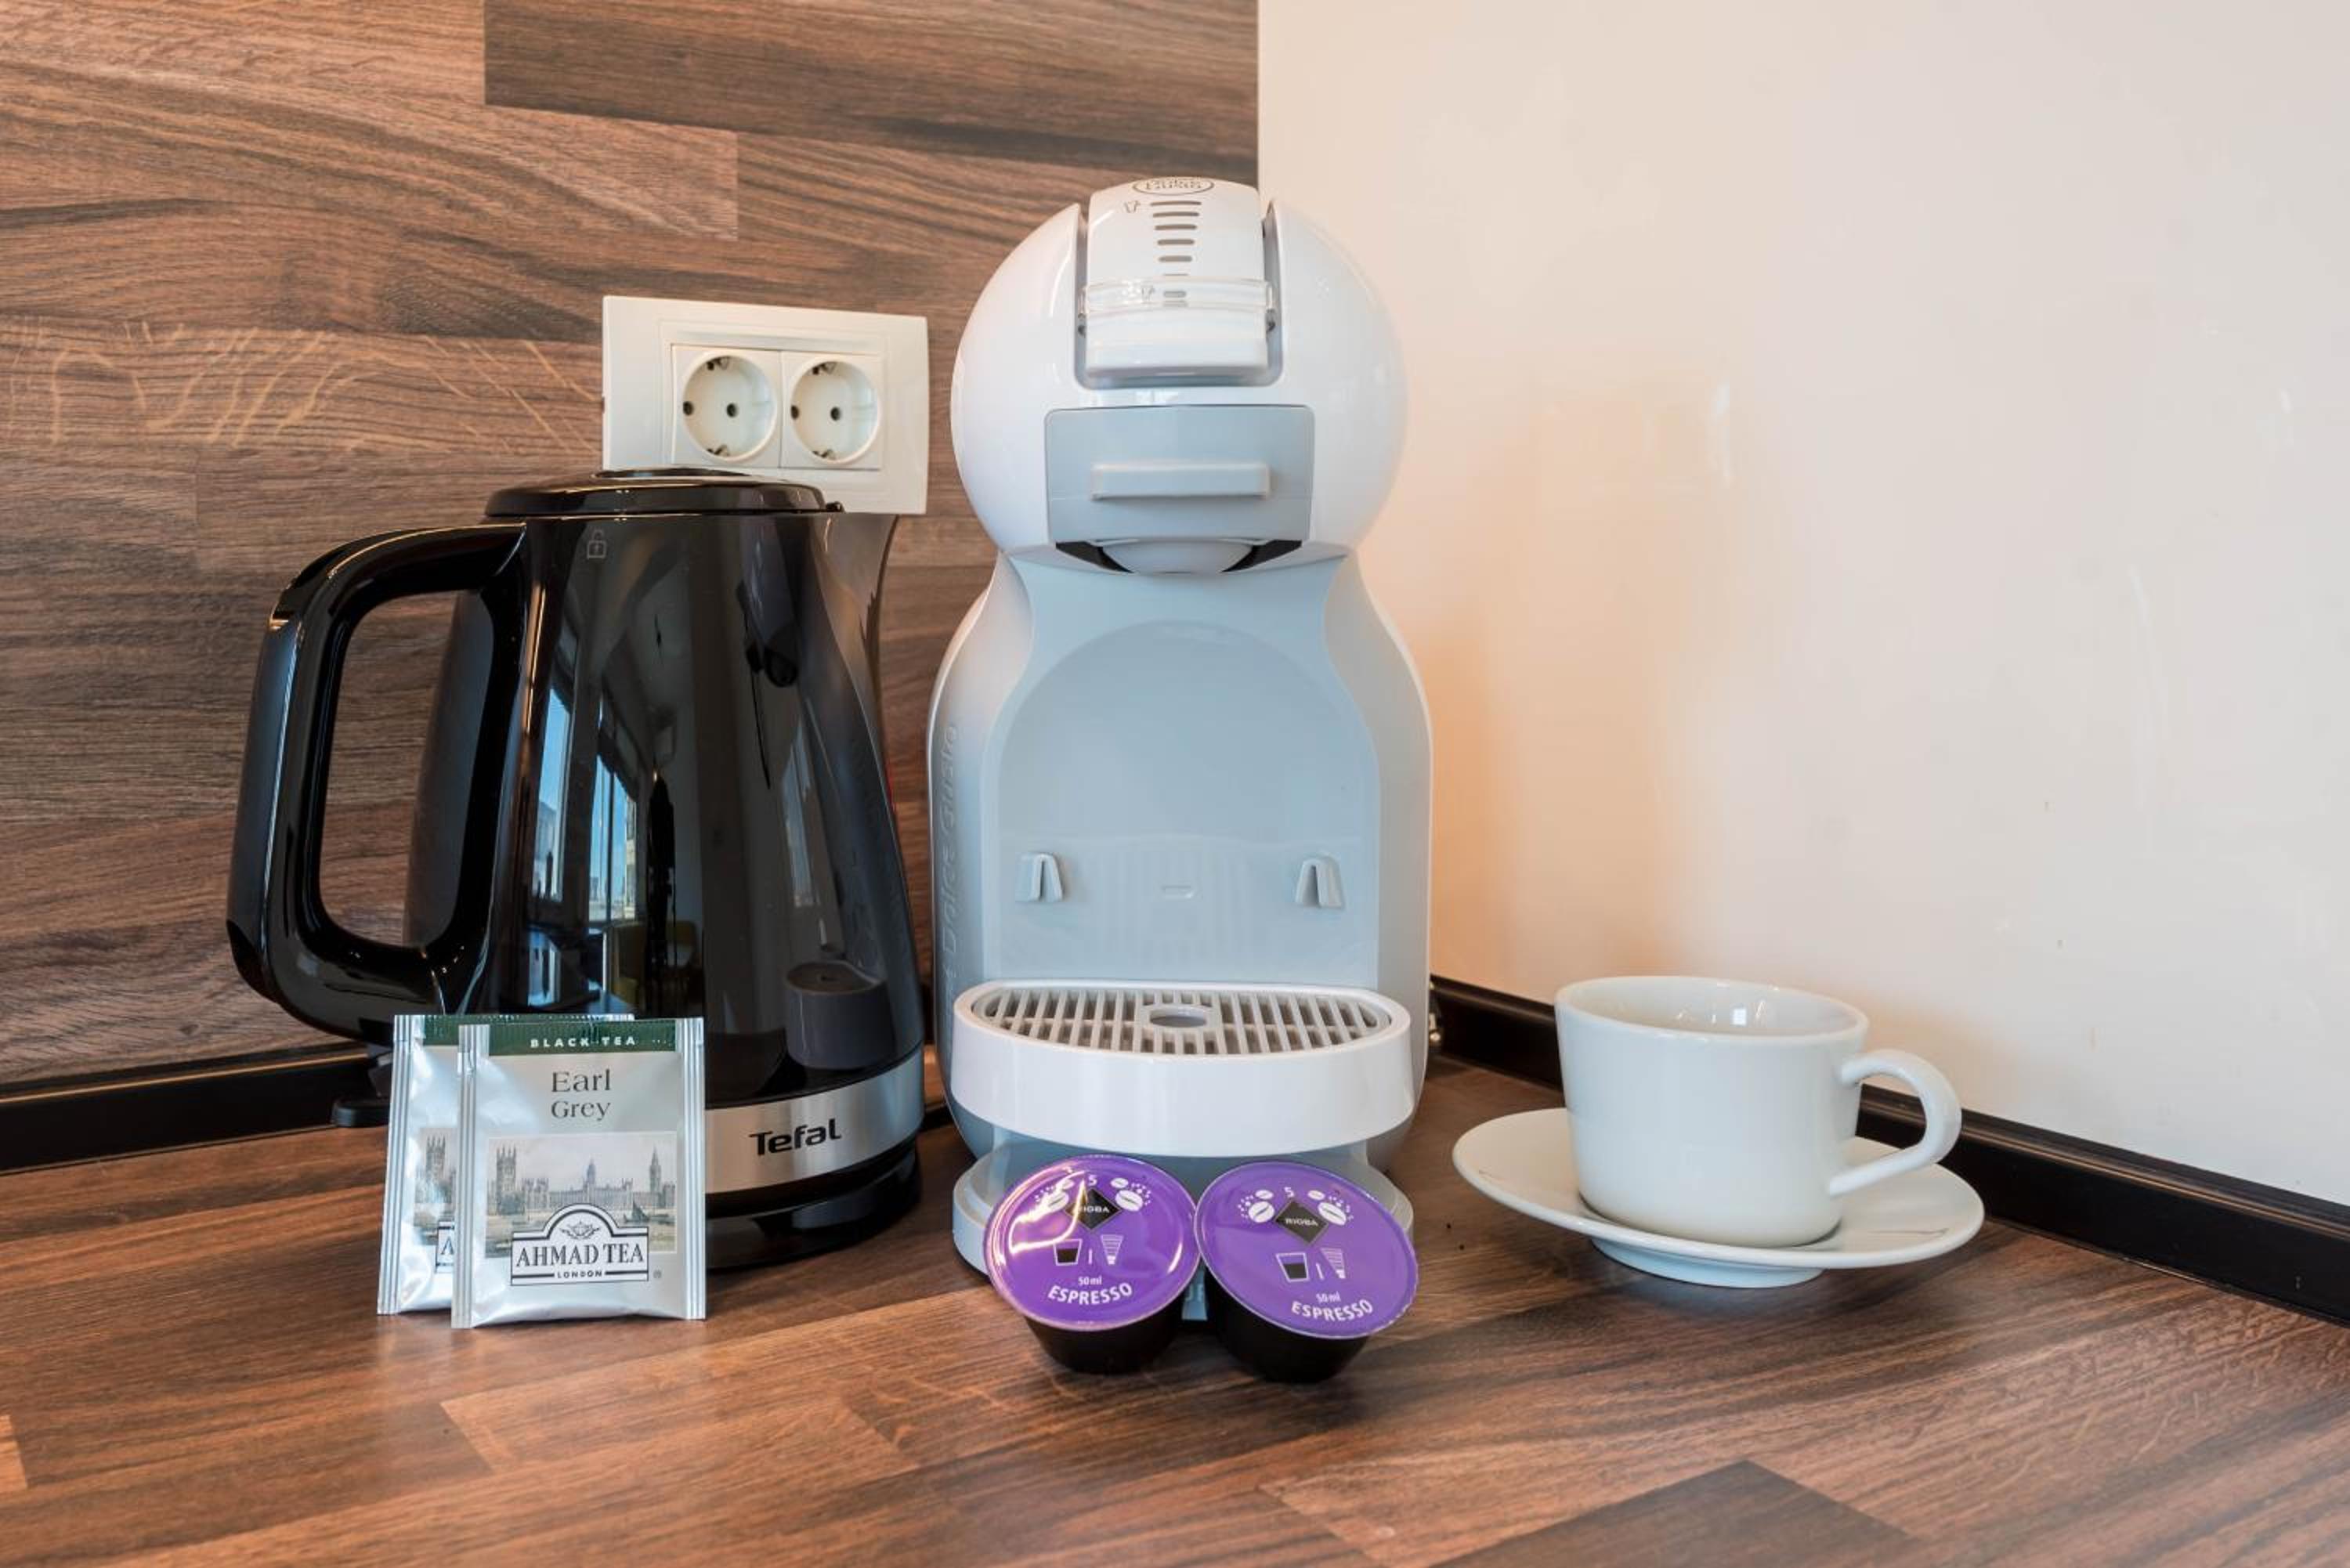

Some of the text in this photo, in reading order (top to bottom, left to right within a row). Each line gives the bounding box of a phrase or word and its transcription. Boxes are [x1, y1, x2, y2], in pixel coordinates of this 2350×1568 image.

[530, 1036, 635, 1048] BLACK TEA
[551, 1068, 611, 1093] Earl
[551, 1100, 611, 1121] Grey
[748, 1118, 842, 1156] Tefal
[1284, 1187, 1294, 1198] 5
[516, 1239, 644, 1266] AHMAD TEA
[558, 1270, 602, 1278] LONDON
[1048, 1282, 1132, 1305] ESPRESSO
[1292, 1299, 1373, 1322] ESPRESSO
